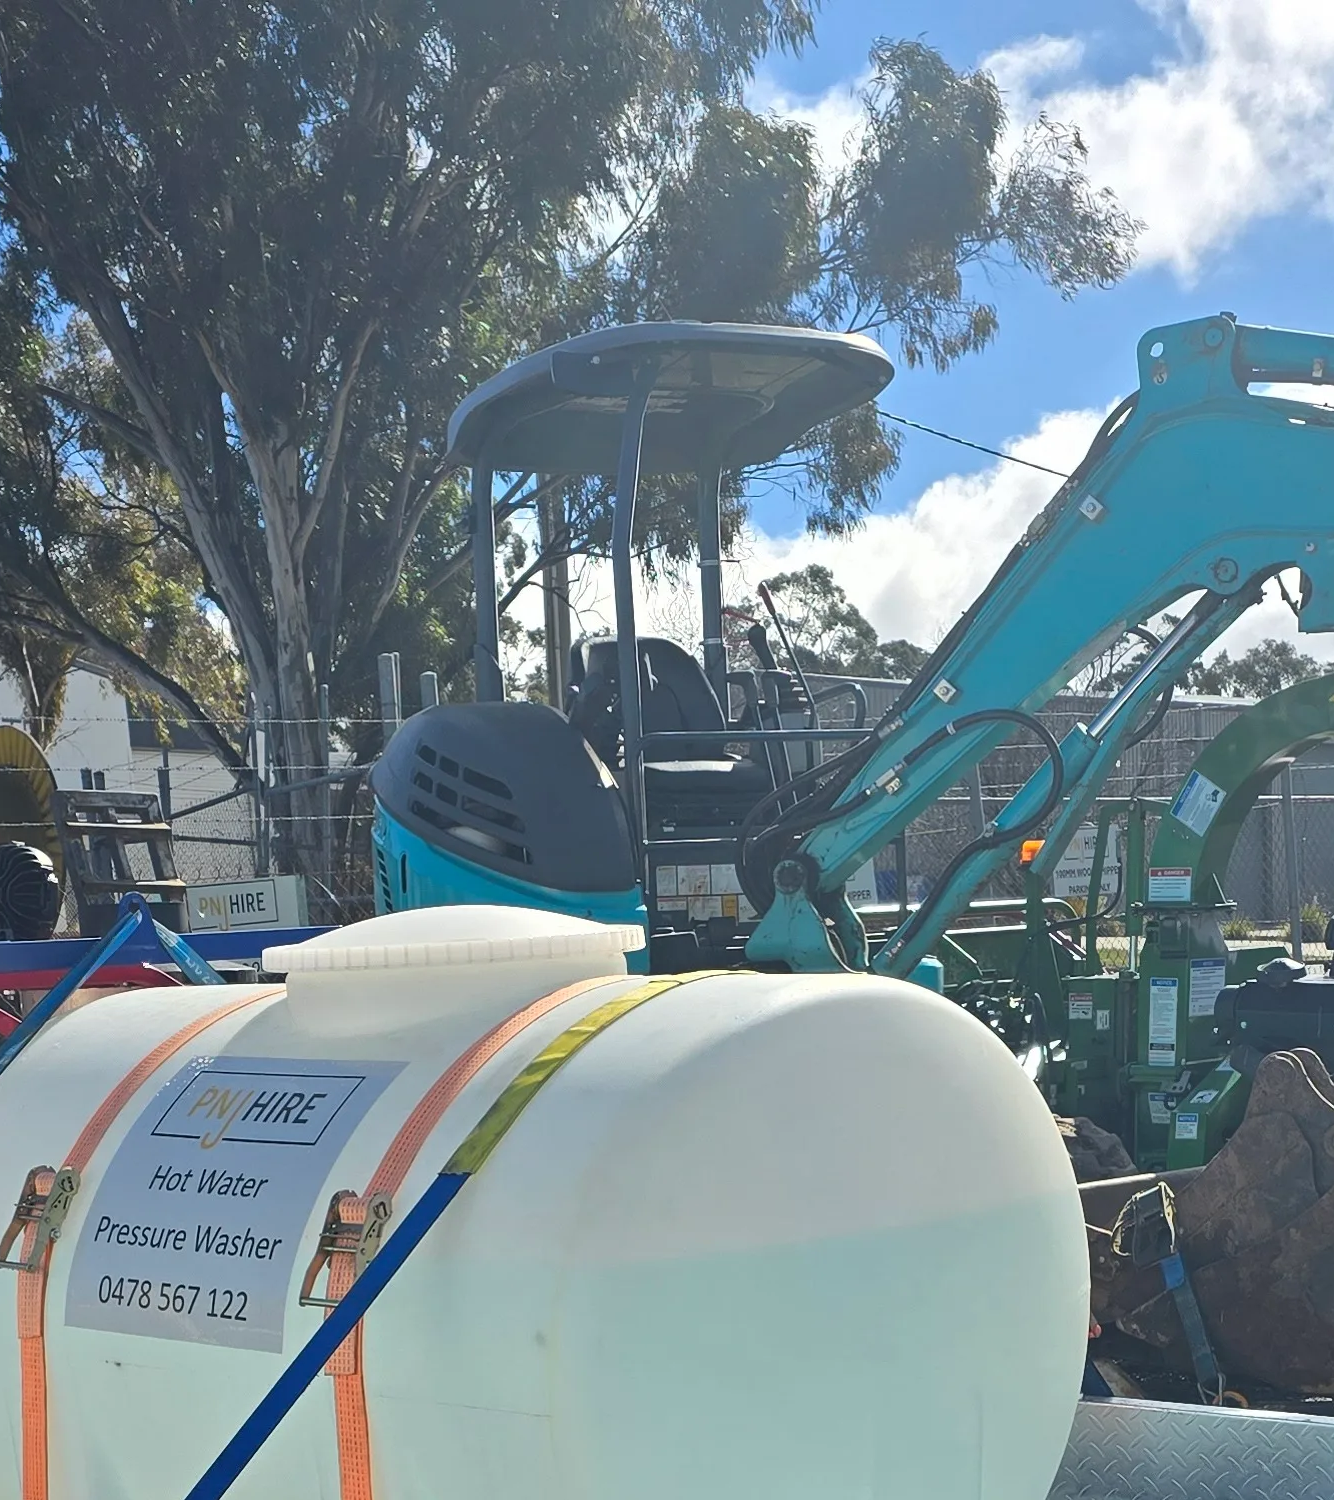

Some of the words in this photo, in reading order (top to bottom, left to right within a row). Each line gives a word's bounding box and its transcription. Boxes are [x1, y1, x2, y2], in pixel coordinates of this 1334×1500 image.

[1068, 884, 1089, 895] PARKIN
[1077, 867, 1091, 877] WOO
[229, 892, 266, 914] HIRE
[187, 1083, 255, 1150] PNJ
[242, 1091, 328, 1125] HIRE
[149, 1164, 195, 1193] Hot
[199, 1168, 269, 1200] Water
[94, 1215, 187, 1252] Pressure
[193, 1224, 283, 1261] Washer
[98, 1275, 152, 1311] 0478
[159, 1282, 200, 1316] 567
[206, 1288, 249, 1322] 122
